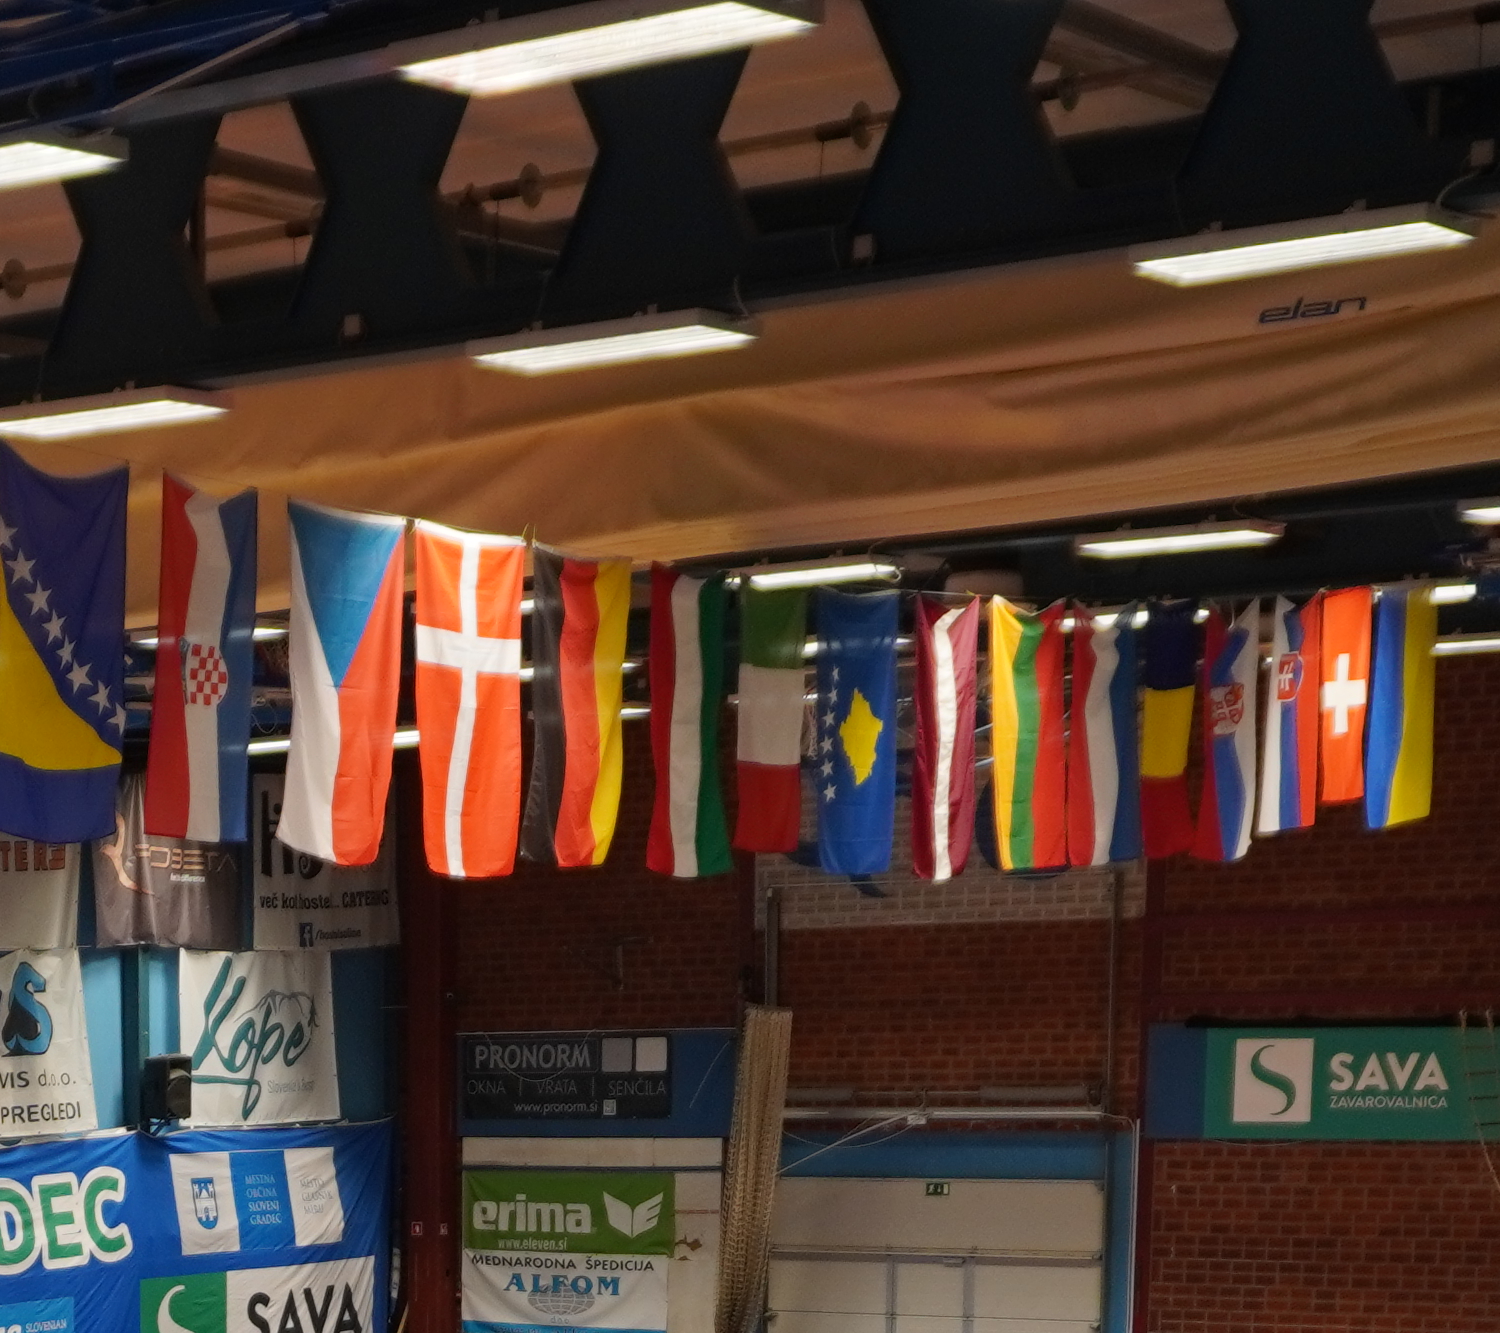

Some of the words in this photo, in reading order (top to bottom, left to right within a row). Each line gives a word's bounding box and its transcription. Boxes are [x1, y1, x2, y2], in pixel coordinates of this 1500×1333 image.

[474, 1043, 590, 1070] PRONORM
[1330, 1052, 1449, 1093] SAVA
[467, 1080, 506, 1095] OKNA
[536, 1079, 577, 1094] VRATA
[608, 1077, 666, 1096] SENČILA
[1, 1100, 82, 1124] PREGLEDI
[514, 1101, 598, 1114] www.pronorm.si
[1329, 1095, 1448, 1110] ZAVAROVALNICA
[250, 1213, 282, 1225] GRADEC
[472, 1194, 592, 1234] erima
[498, 1238, 568, 1253] www.eleven.si
[471, 1254, 576, 1270] MEDNARODNA
[585, 1254, 654, 1272] ŠPEDICIJA
[504, 1273, 621, 1296] ALFOM
